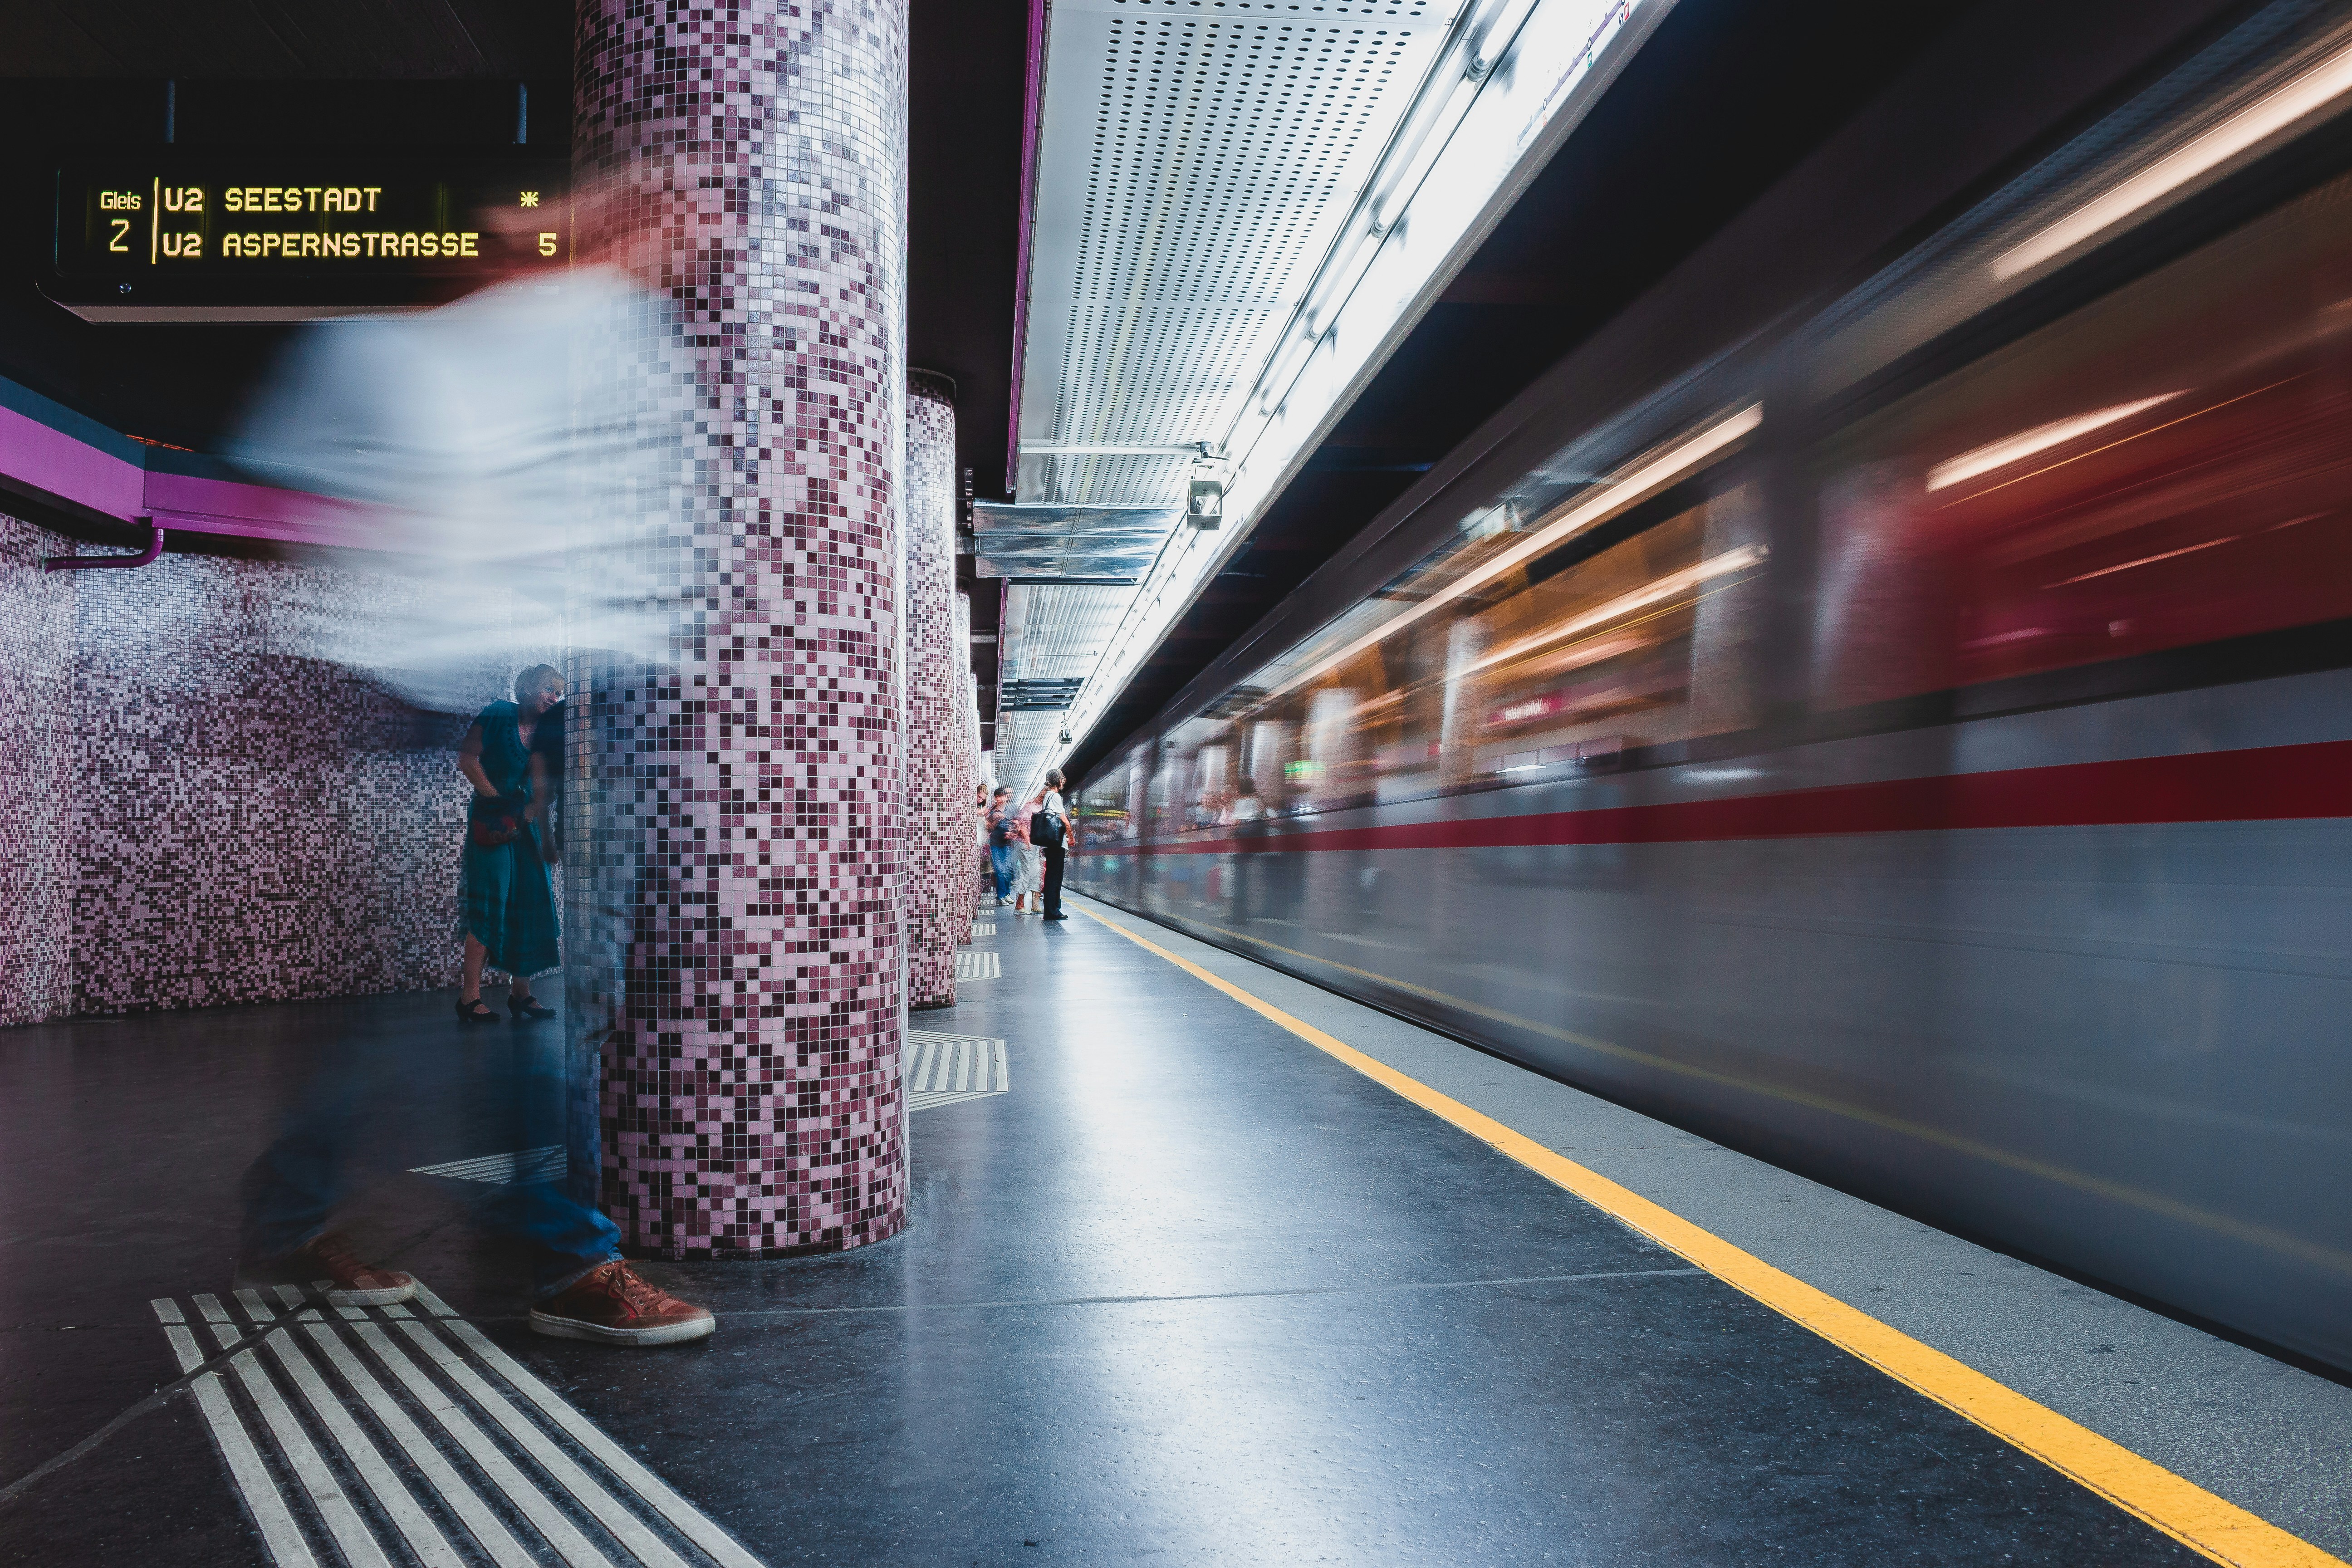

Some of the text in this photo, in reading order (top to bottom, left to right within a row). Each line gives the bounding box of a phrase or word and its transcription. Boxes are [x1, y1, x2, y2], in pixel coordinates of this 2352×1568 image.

[100, 191, 141, 210] Gleis
[164, 187, 382, 212] U2 SEESTADT
[110, 219, 130, 251] 2
[162, 232, 557, 257] U2 ASPERNSTRASSE 5
